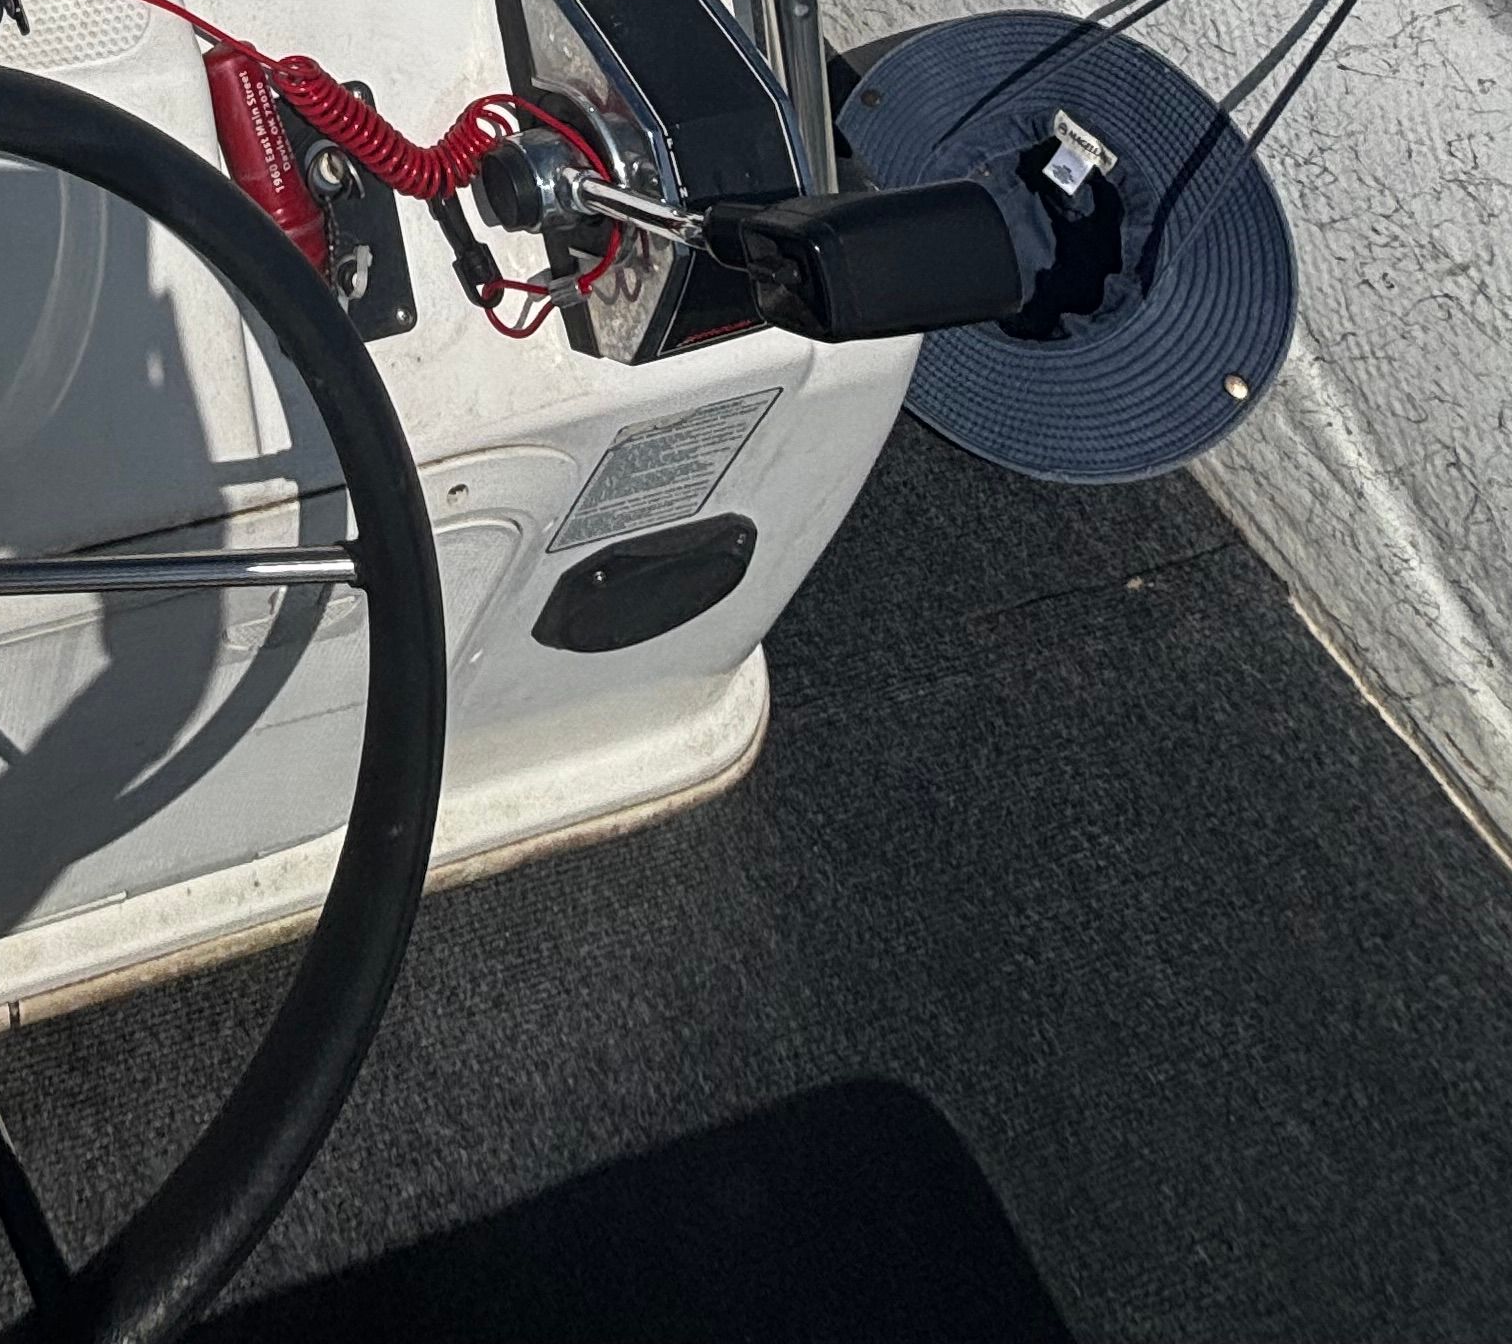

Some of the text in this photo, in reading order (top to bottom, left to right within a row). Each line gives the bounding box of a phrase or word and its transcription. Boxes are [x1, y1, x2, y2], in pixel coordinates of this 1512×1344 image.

[239, 70, 257, 106] Street
[251, 107, 267, 137] Main
[268, 117, 279, 135] OK
[260, 137, 275, 163] East
[269, 163, 285, 193] 1960
[679, 187, 688, 199] N
